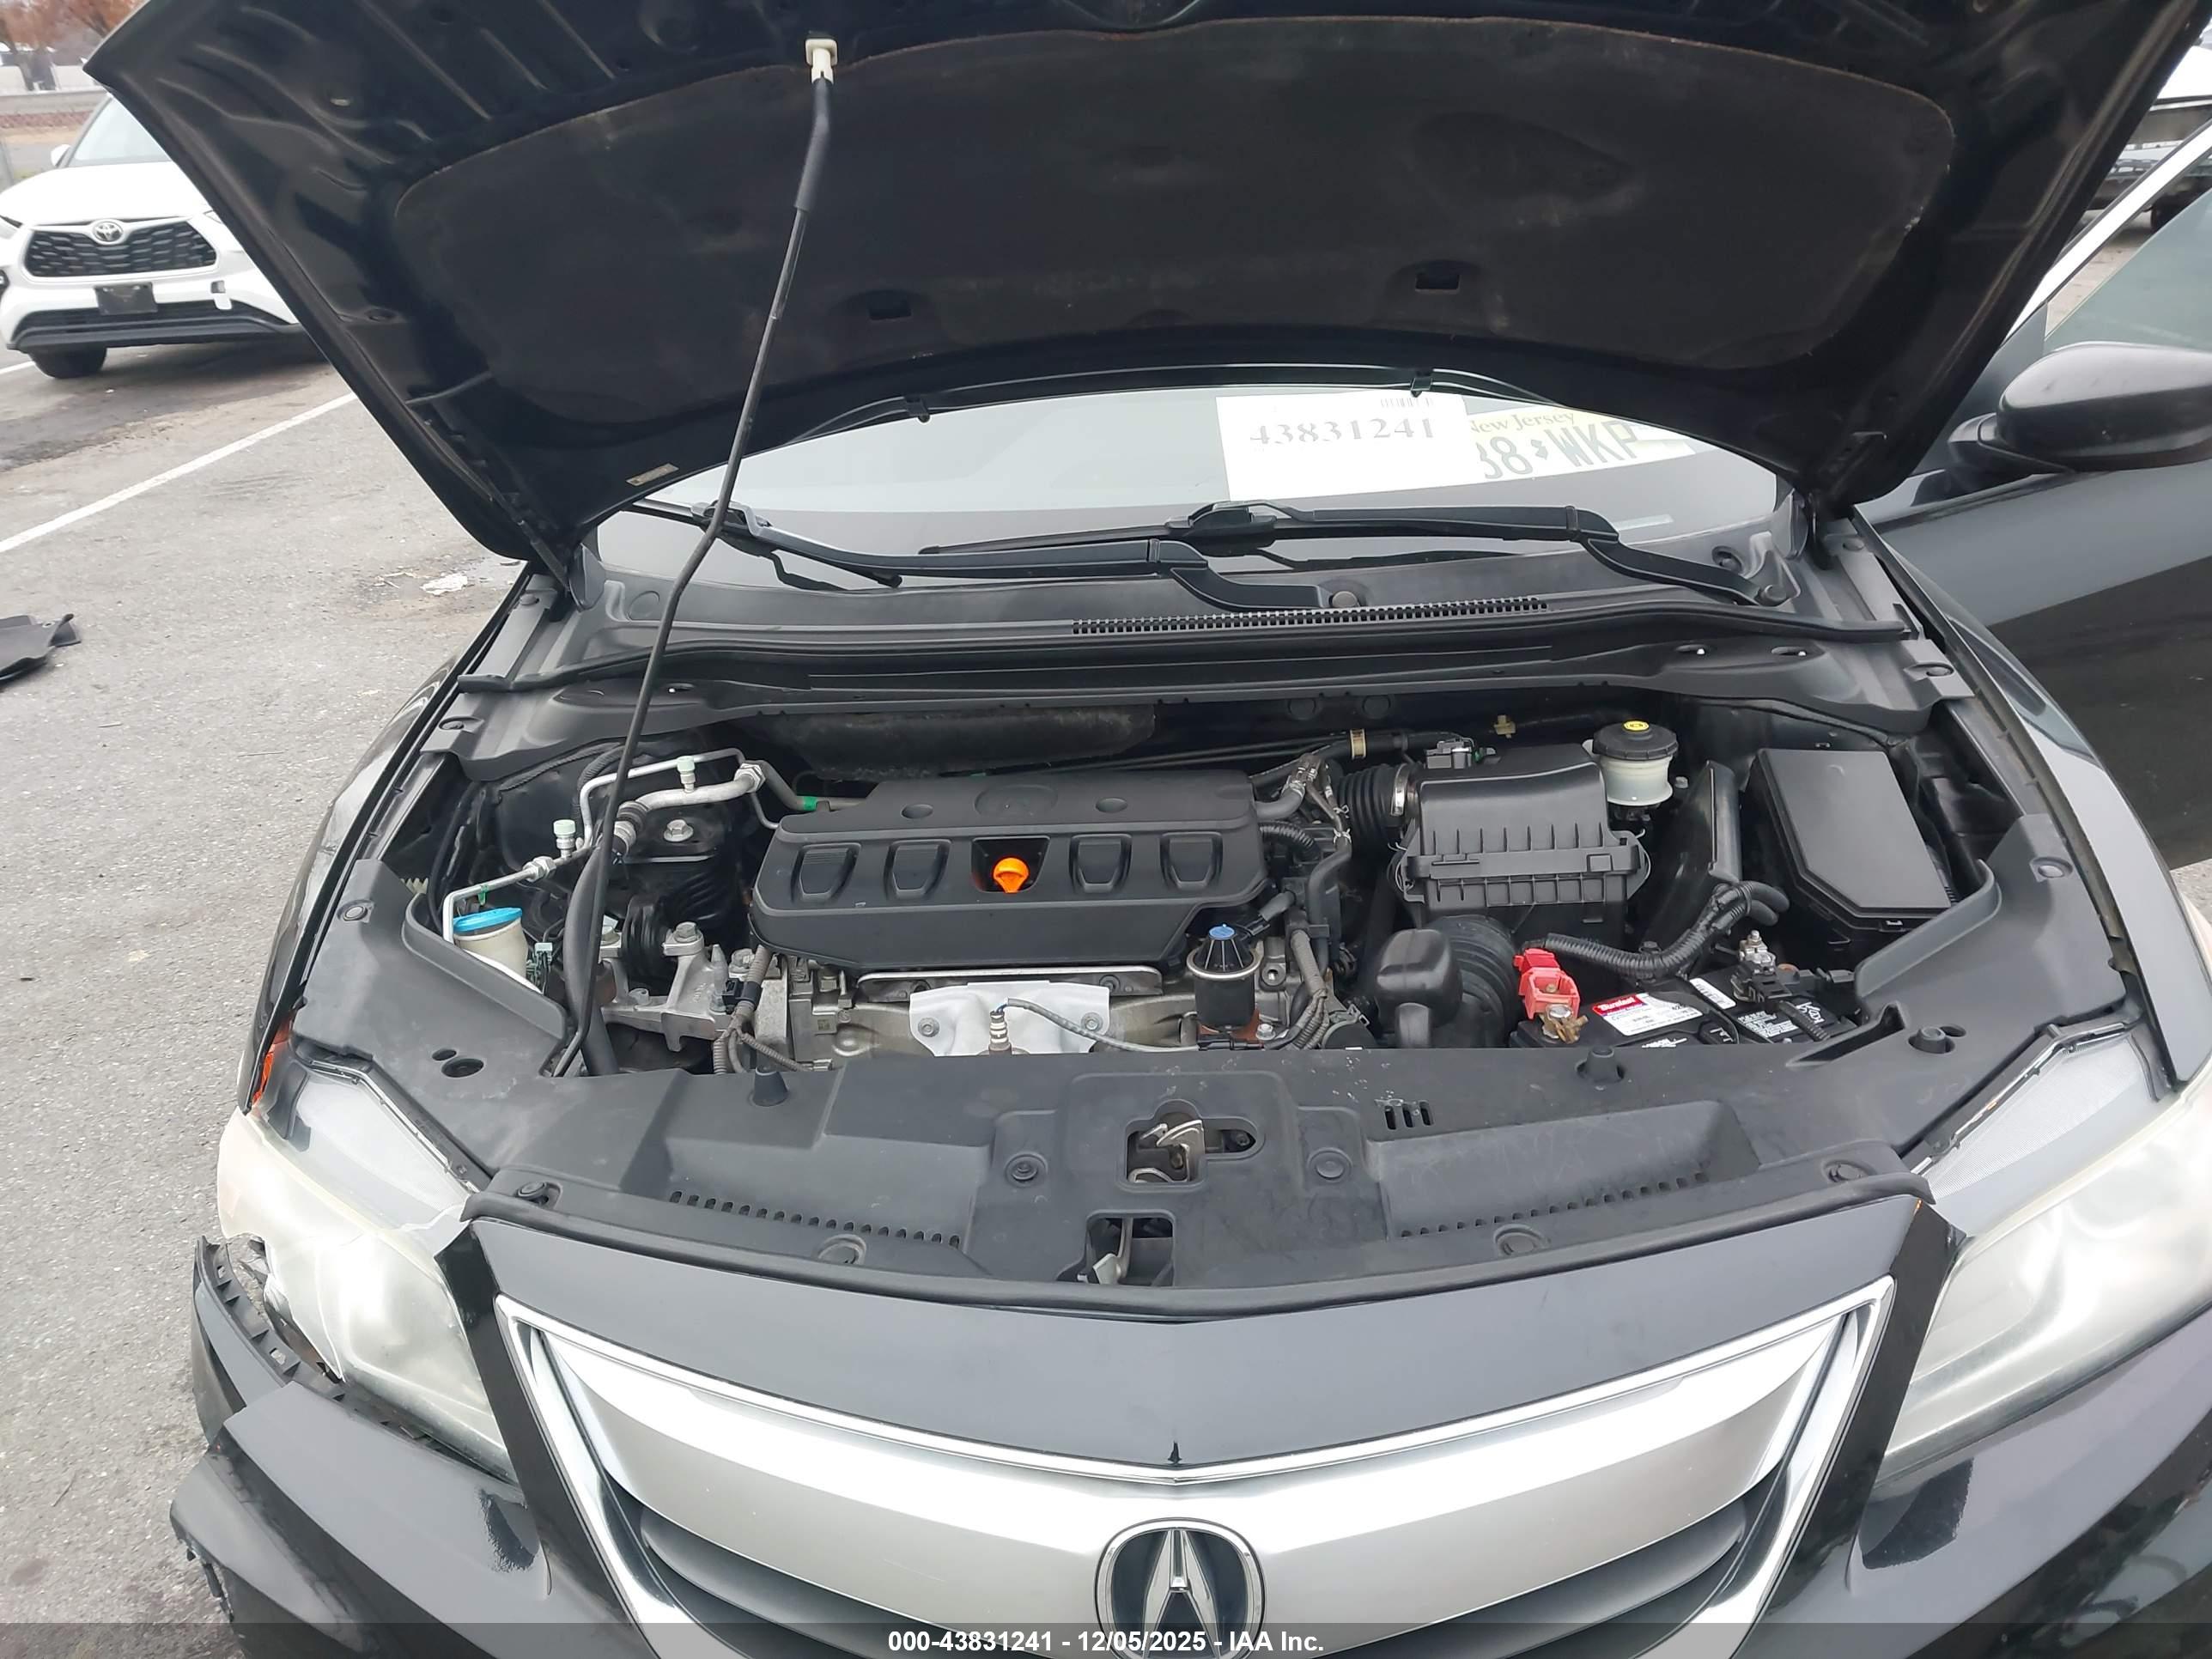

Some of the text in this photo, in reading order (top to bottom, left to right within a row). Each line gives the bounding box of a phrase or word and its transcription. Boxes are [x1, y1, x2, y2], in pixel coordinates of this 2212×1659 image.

[1249, 417, 1434, 445] 43831241
[1510, 411, 1575, 431] Jersey
[1543, 419, 1638, 467] WKP
